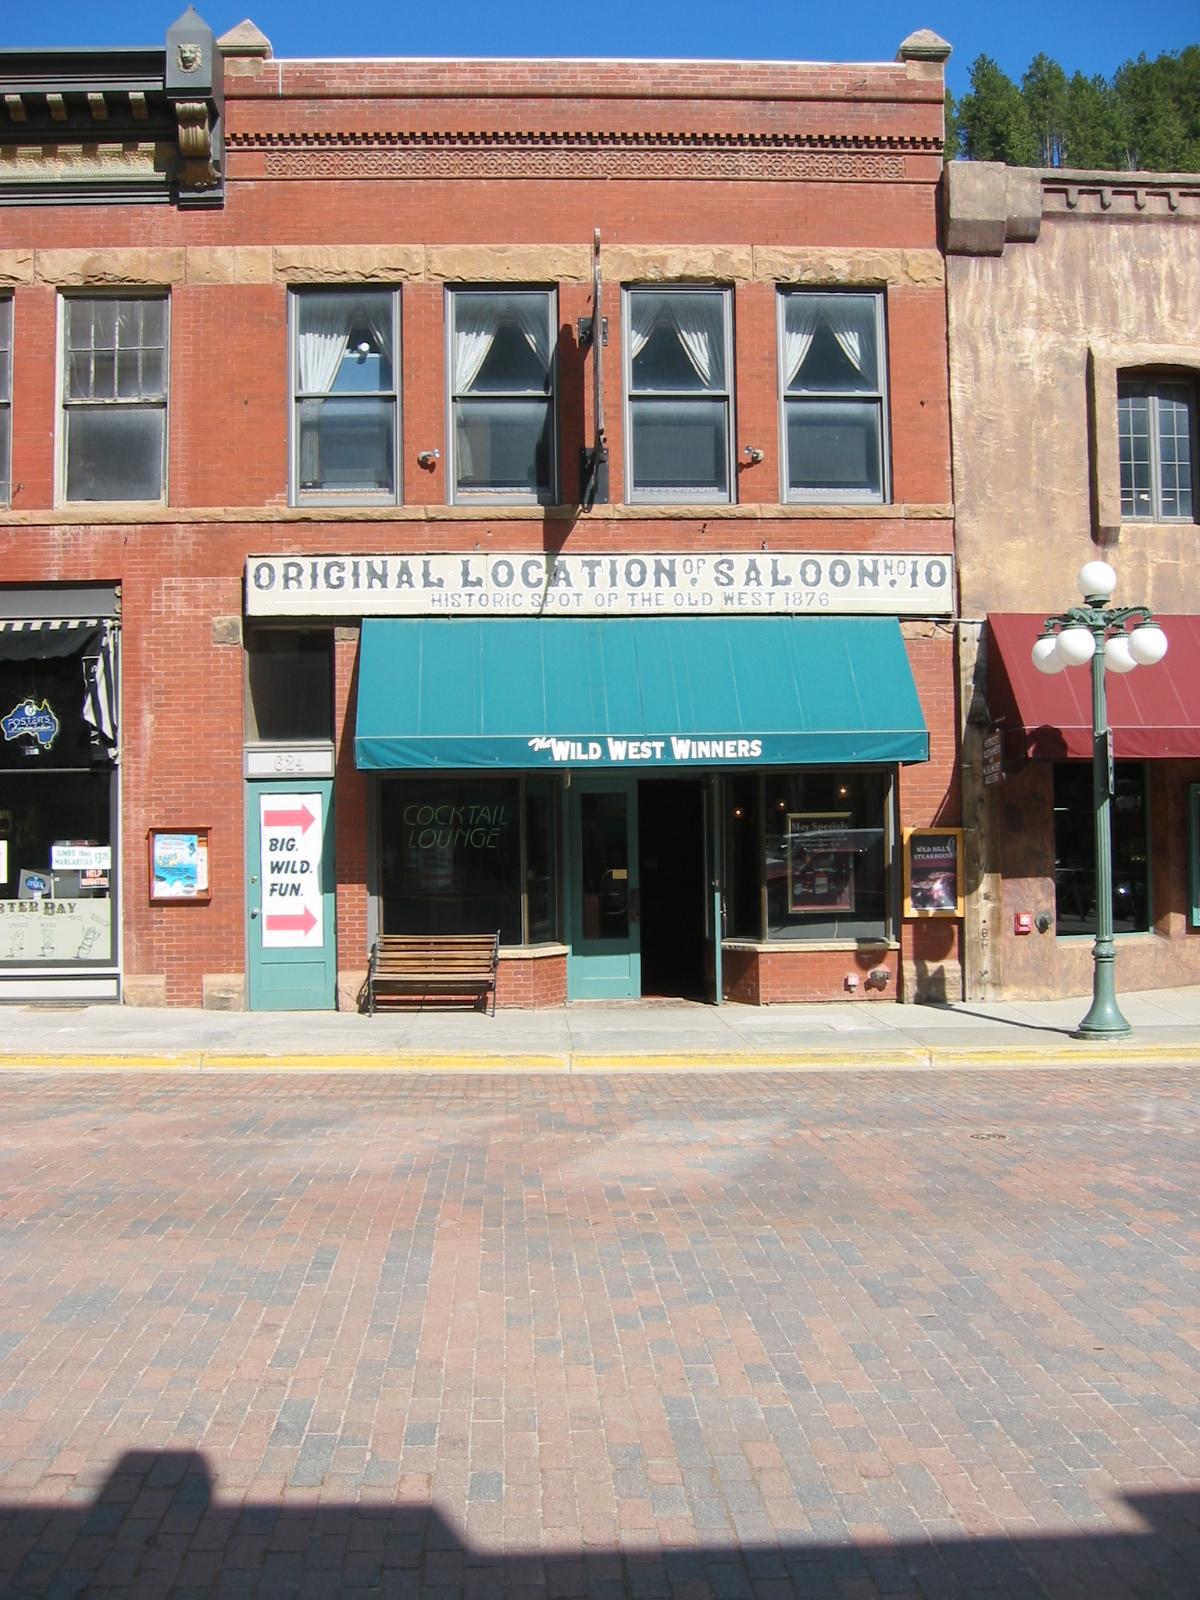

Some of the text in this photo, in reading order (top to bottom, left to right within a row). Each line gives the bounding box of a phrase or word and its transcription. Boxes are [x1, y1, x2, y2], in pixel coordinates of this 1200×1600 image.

[253, 559, 445, 591] ORIGINAL
[460, 558, 677, 589] LOCATION
[713, 558, 881, 588] SALOON
[910, 559, 947, 588] 10
[431, 592, 830, 608] HISTORIC SPOT OF THE OLD WEST 1876
[550, 737, 601, 761] WILD
[607, 737, 665, 761] WEST
[670, 736, 763, 760] WINNERS
[274, 755, 304, 772] 624
[403, 805, 508, 825] COCKTAIL
[269, 838, 299, 851] BIG.
[408, 828, 501, 848] LOUNGE
[269, 859, 313, 874] WILD.
[269, 882, 303, 897] FUN.
[43, 902, 77, 916] BAY
